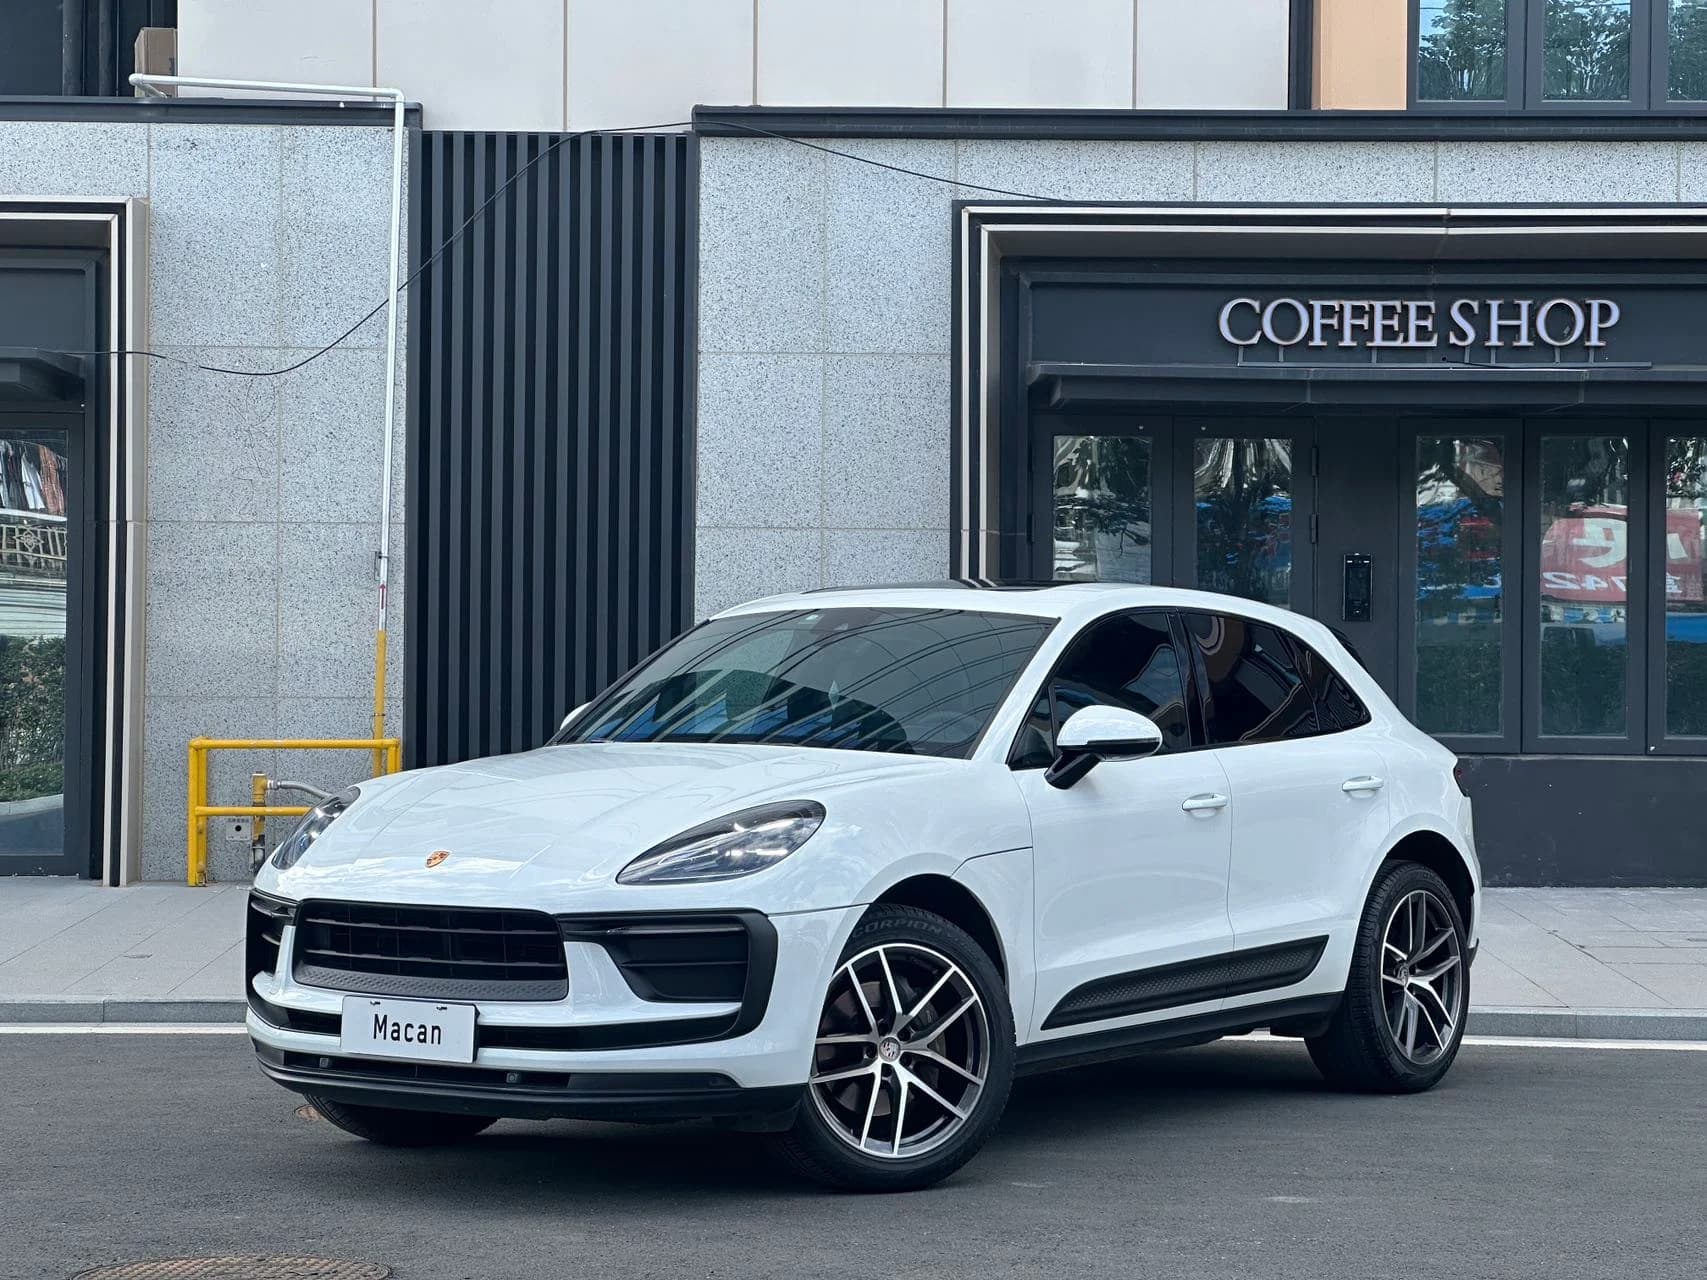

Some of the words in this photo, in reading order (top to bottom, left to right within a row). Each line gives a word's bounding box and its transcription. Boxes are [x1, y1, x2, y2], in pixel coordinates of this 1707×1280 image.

[1218, 297, 1438, 348] COFFEE
[1449, 297, 1621, 348] SHOP
[373, 1013, 442, 1045] Macan
